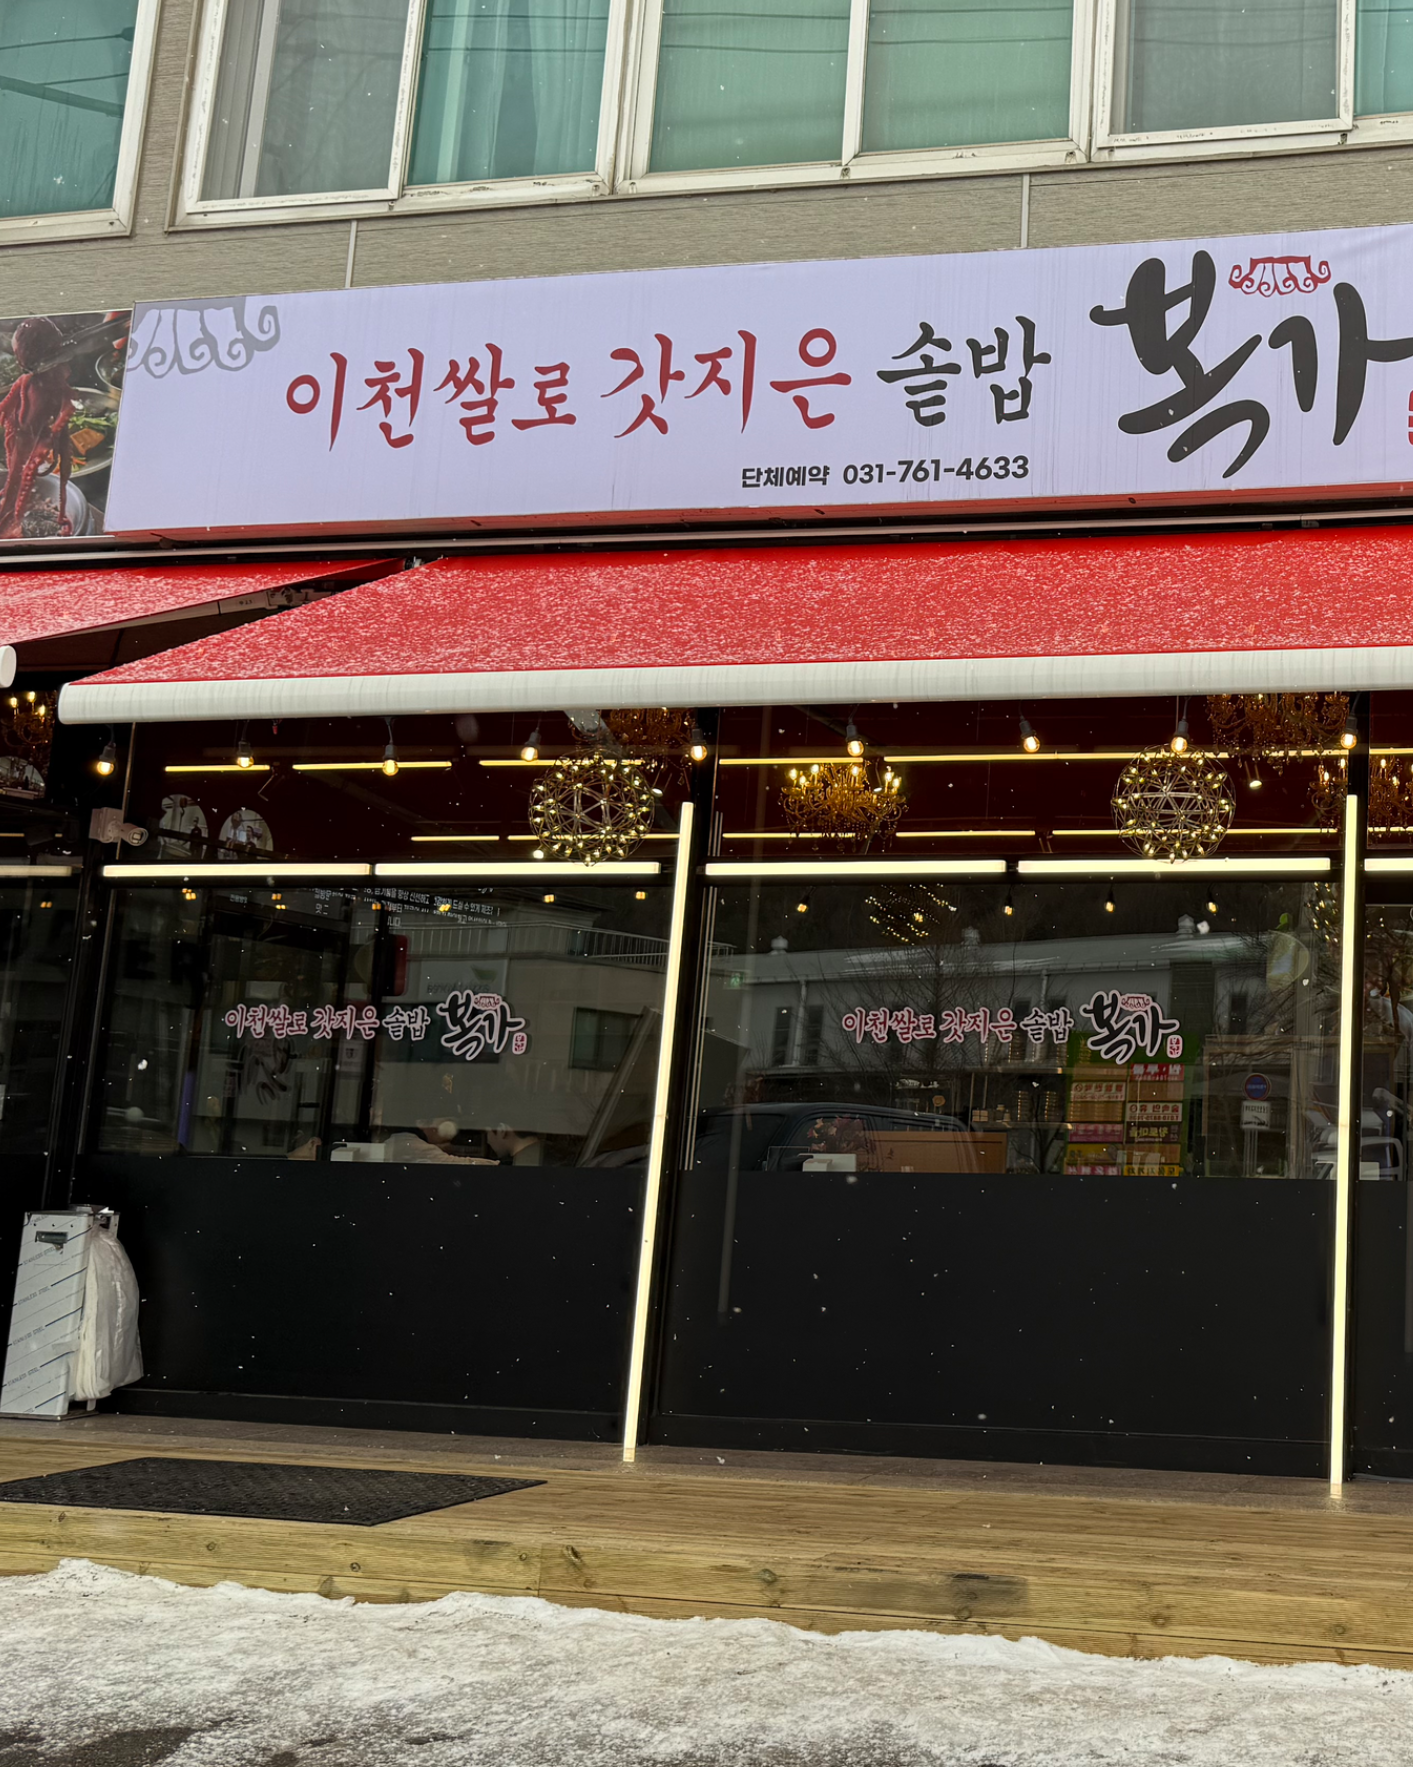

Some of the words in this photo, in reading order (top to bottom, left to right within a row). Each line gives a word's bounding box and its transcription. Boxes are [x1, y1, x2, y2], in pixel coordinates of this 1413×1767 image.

[286, 343, 576, 451] 이천쌀로
[600, 329, 852, 439] 갓지은
[876, 315, 1052, 427] 솥밥
[741, 465, 830, 489] 단체예약
[842, 454, 1030, 486] 031-761-4633
[224, 1003, 308, 1040] 이천쌀로
[311, 1004, 381, 1041] 갓지은
[382, 1005, 431, 1041] 솥밥
[436, 989, 525, 1061] 복가
[842, 1006, 936, 1044] 이천쌀로
[939, 1007, 1017, 1045] 갓지은
[1020, 1008, 1074, 1045] 솥밥
[1080, 989, 1181, 1065] 복가
